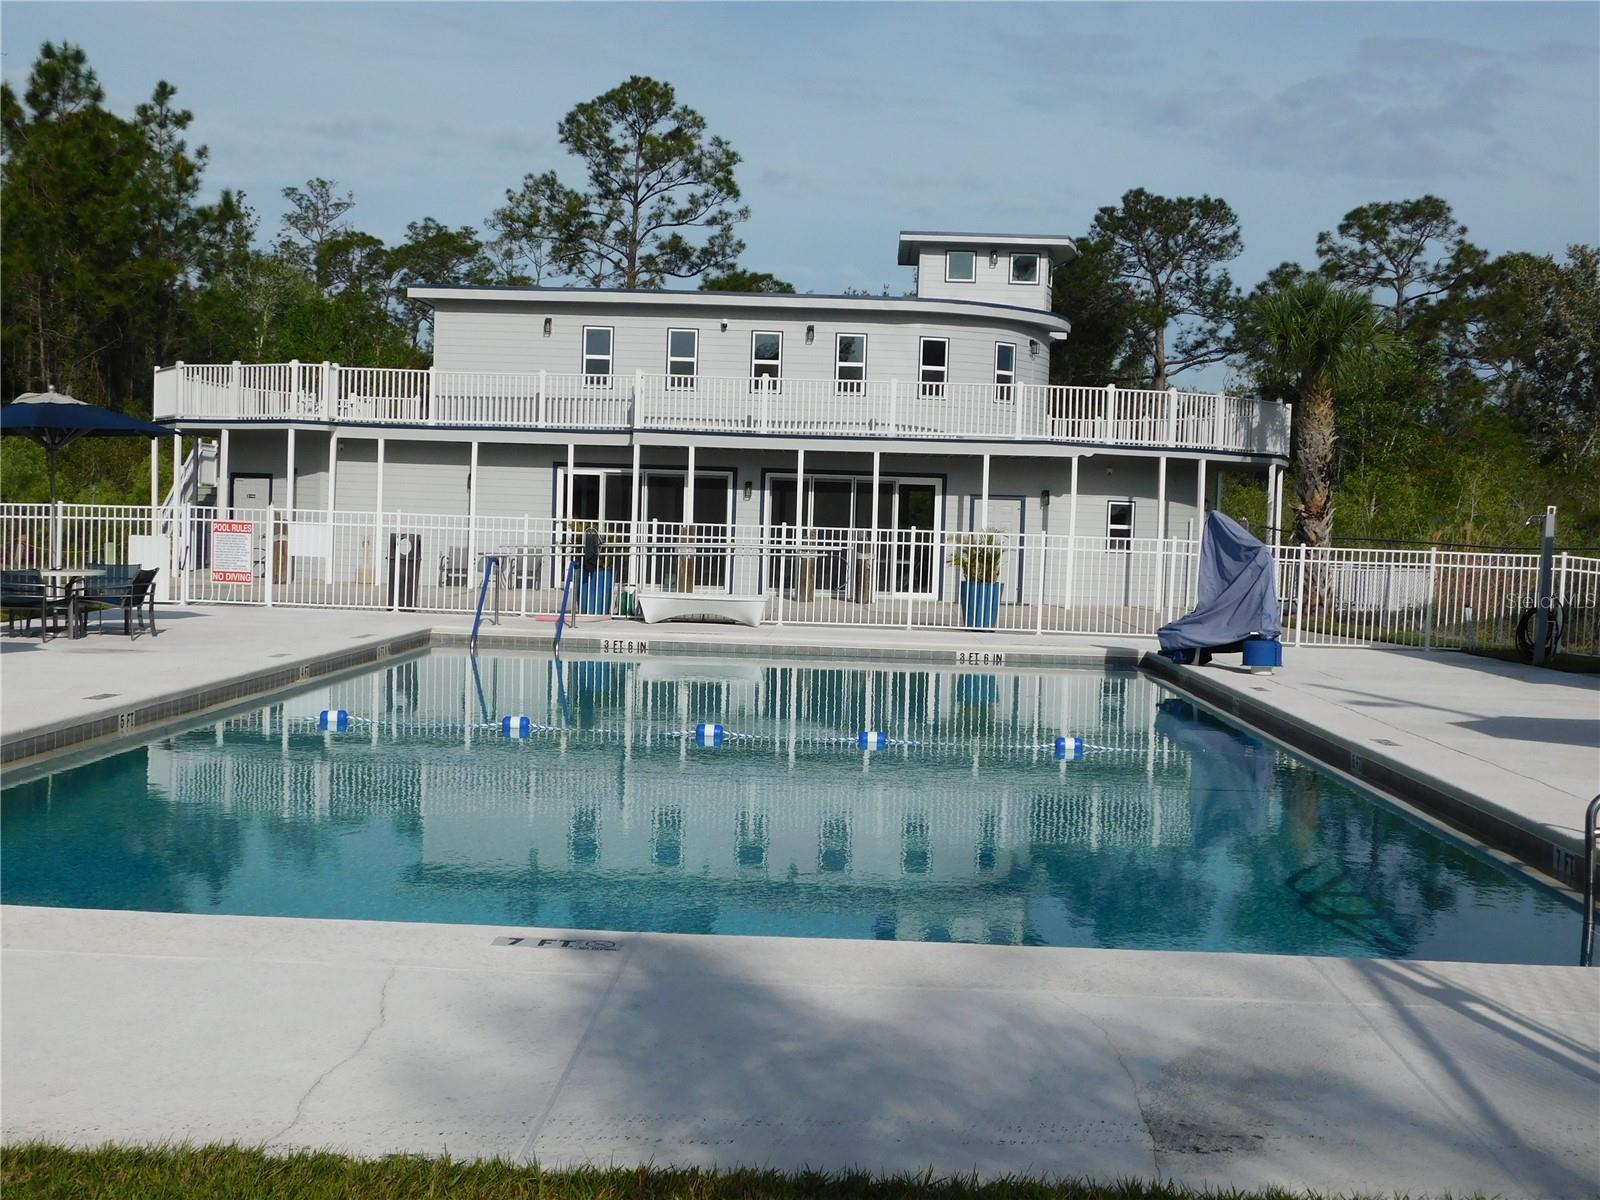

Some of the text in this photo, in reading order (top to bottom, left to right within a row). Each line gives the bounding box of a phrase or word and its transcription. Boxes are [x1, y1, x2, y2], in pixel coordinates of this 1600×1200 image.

[214, 523, 252, 532] POOL RULES
[212, 572, 251, 582] NO DIVING
[508, 937, 525, 946] 7
